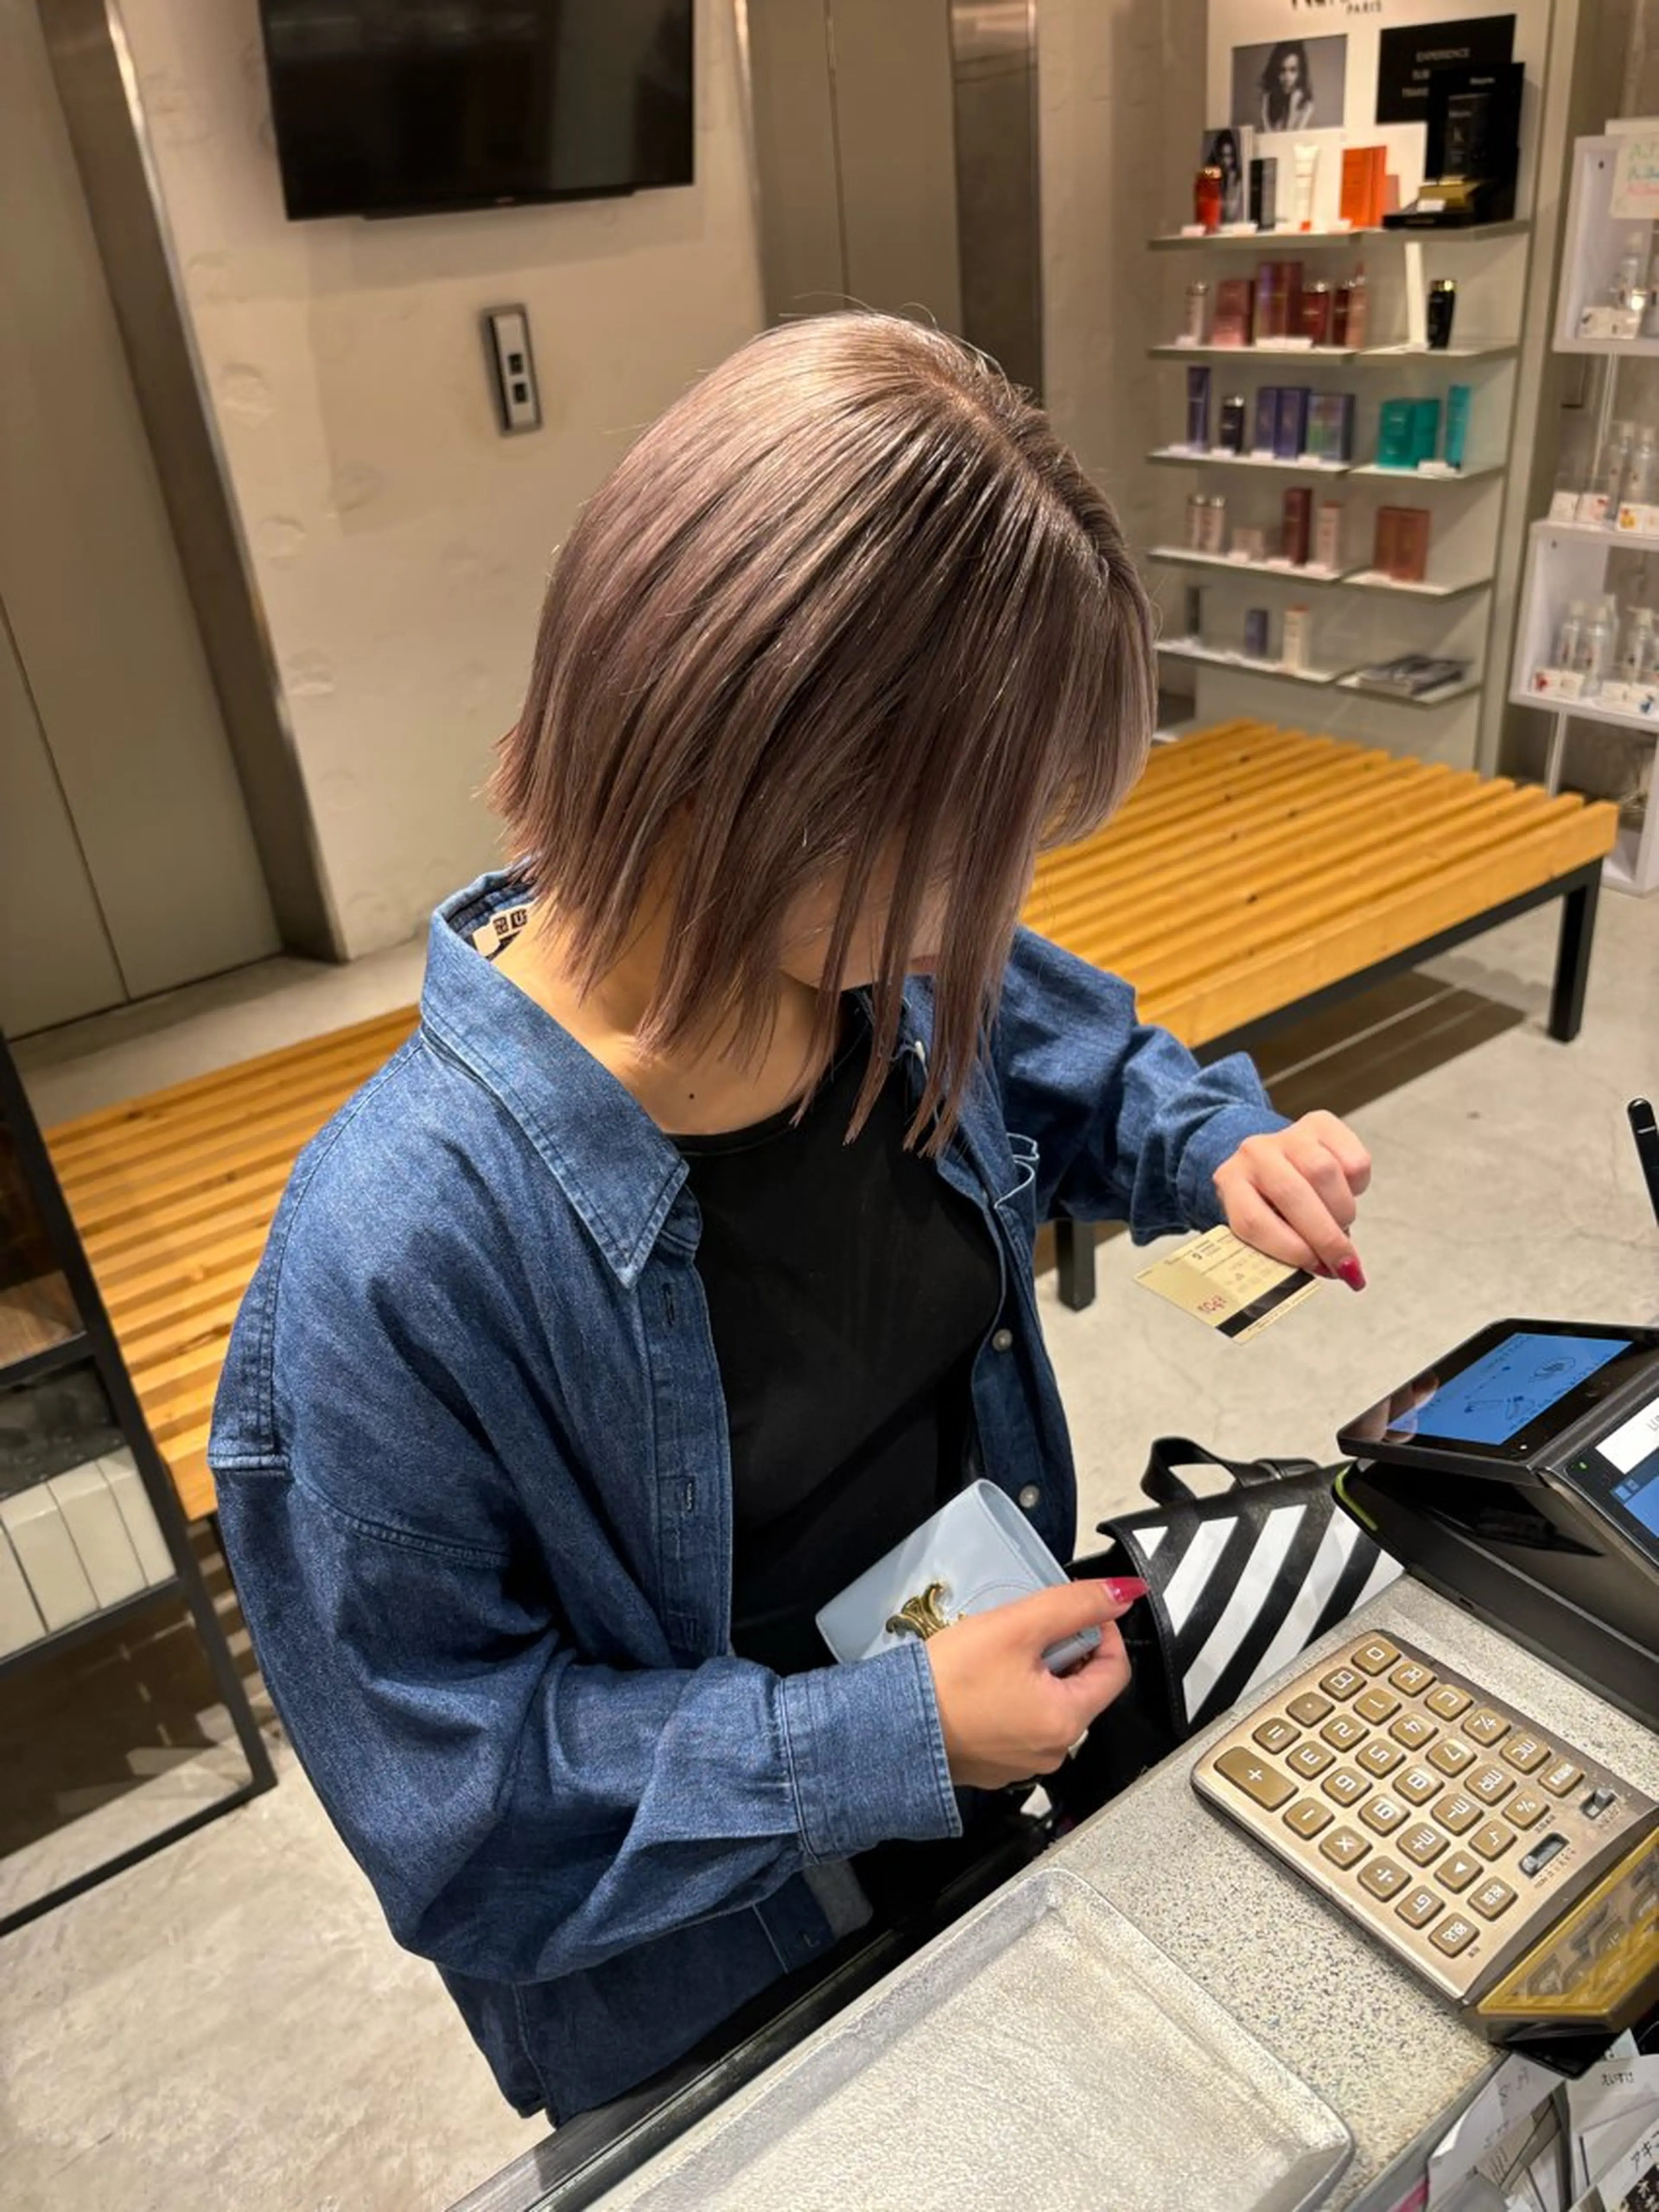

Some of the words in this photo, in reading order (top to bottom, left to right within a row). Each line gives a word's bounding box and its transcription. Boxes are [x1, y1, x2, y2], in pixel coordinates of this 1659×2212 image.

[1346, 1, 1382, 15] PARIS
[1366, 1646, 1385, 1661] 0
[1437, 1691, 1458, 1707] C
[1332, 1721, 1354, 1737] 2
[1403, 1720, 1422, 1734] 4
[1300, 1748, 1322, 1765] 3
[1368, 1745, 1390, 1763] 5
[1443, 1746, 1462, 1761] 7
[1335, 1775, 1356, 1792] 6
[1407, 1773, 1427, 1790] 8
[1372, 1802, 1395, 1820] 9
[1411, 1893, 1433, 1915] GT
